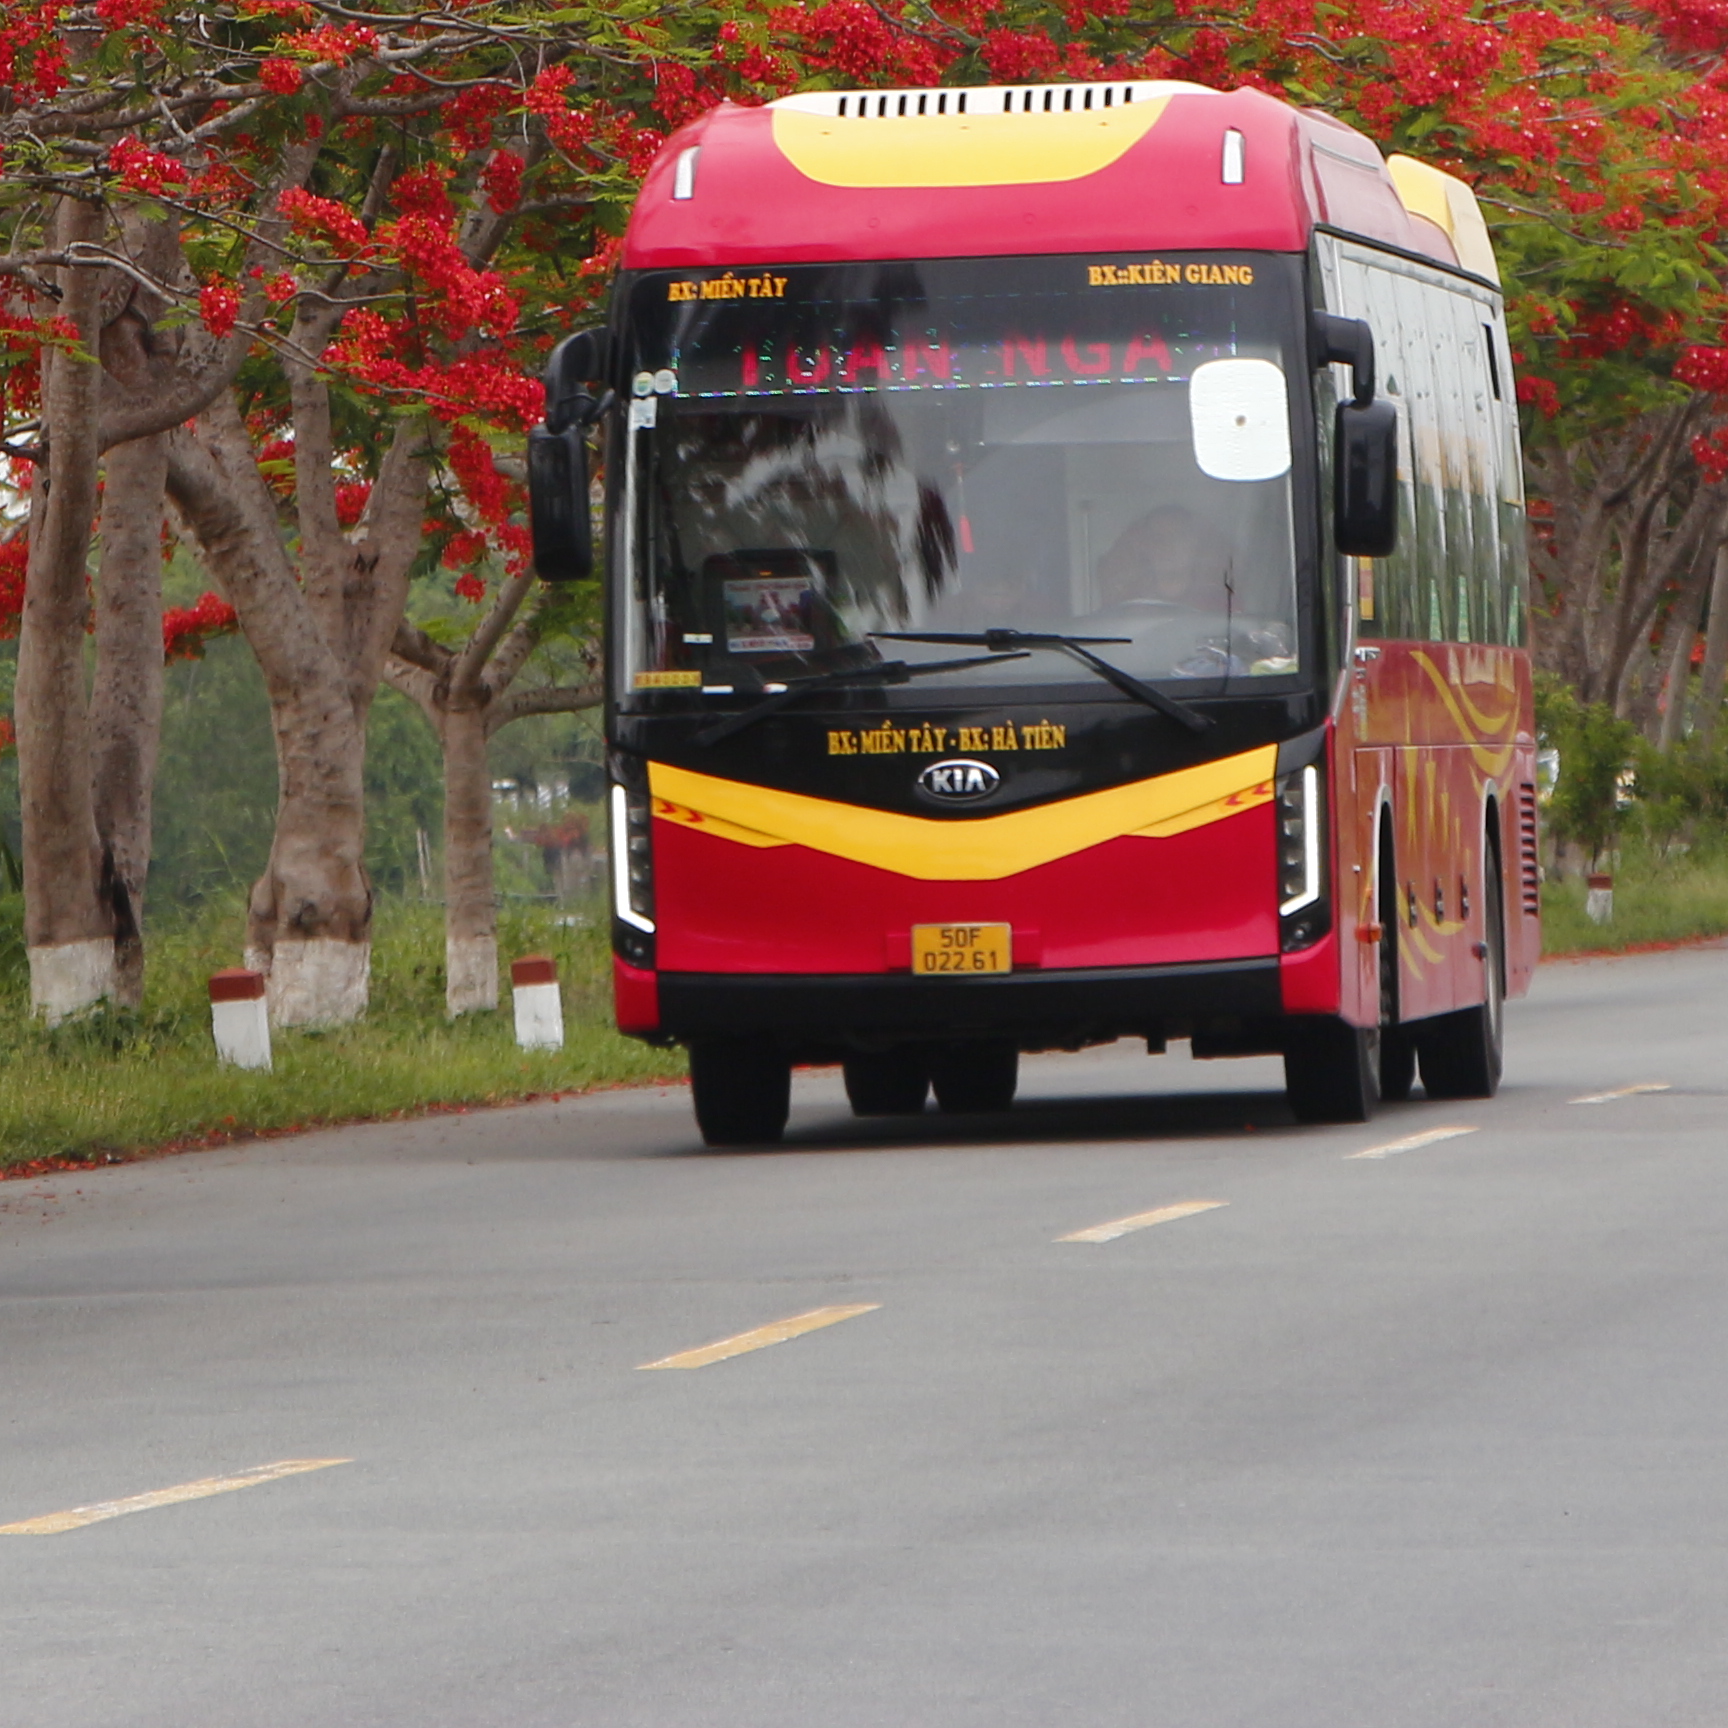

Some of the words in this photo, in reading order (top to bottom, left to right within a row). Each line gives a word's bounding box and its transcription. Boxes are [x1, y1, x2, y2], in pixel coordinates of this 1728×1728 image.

[668, 281, 698, 301] BX:
[748, 272, 788, 298] TÂY
[1185, 263, 1254, 286] GIANG
[828, 731, 858, 755] BX:
[860, 719, 906, 754] MIỀN
[910, 721, 947, 752] TÂY
[958, 727, 989, 752] BX:
[991, 719, 1018, 750] HÀ
[1022, 718, 1066, 750] TIÊN
[931, 768, 986, 793] KIA
[940, 928, 981, 948] 50F
[924, 950, 998, 971] 022.61
